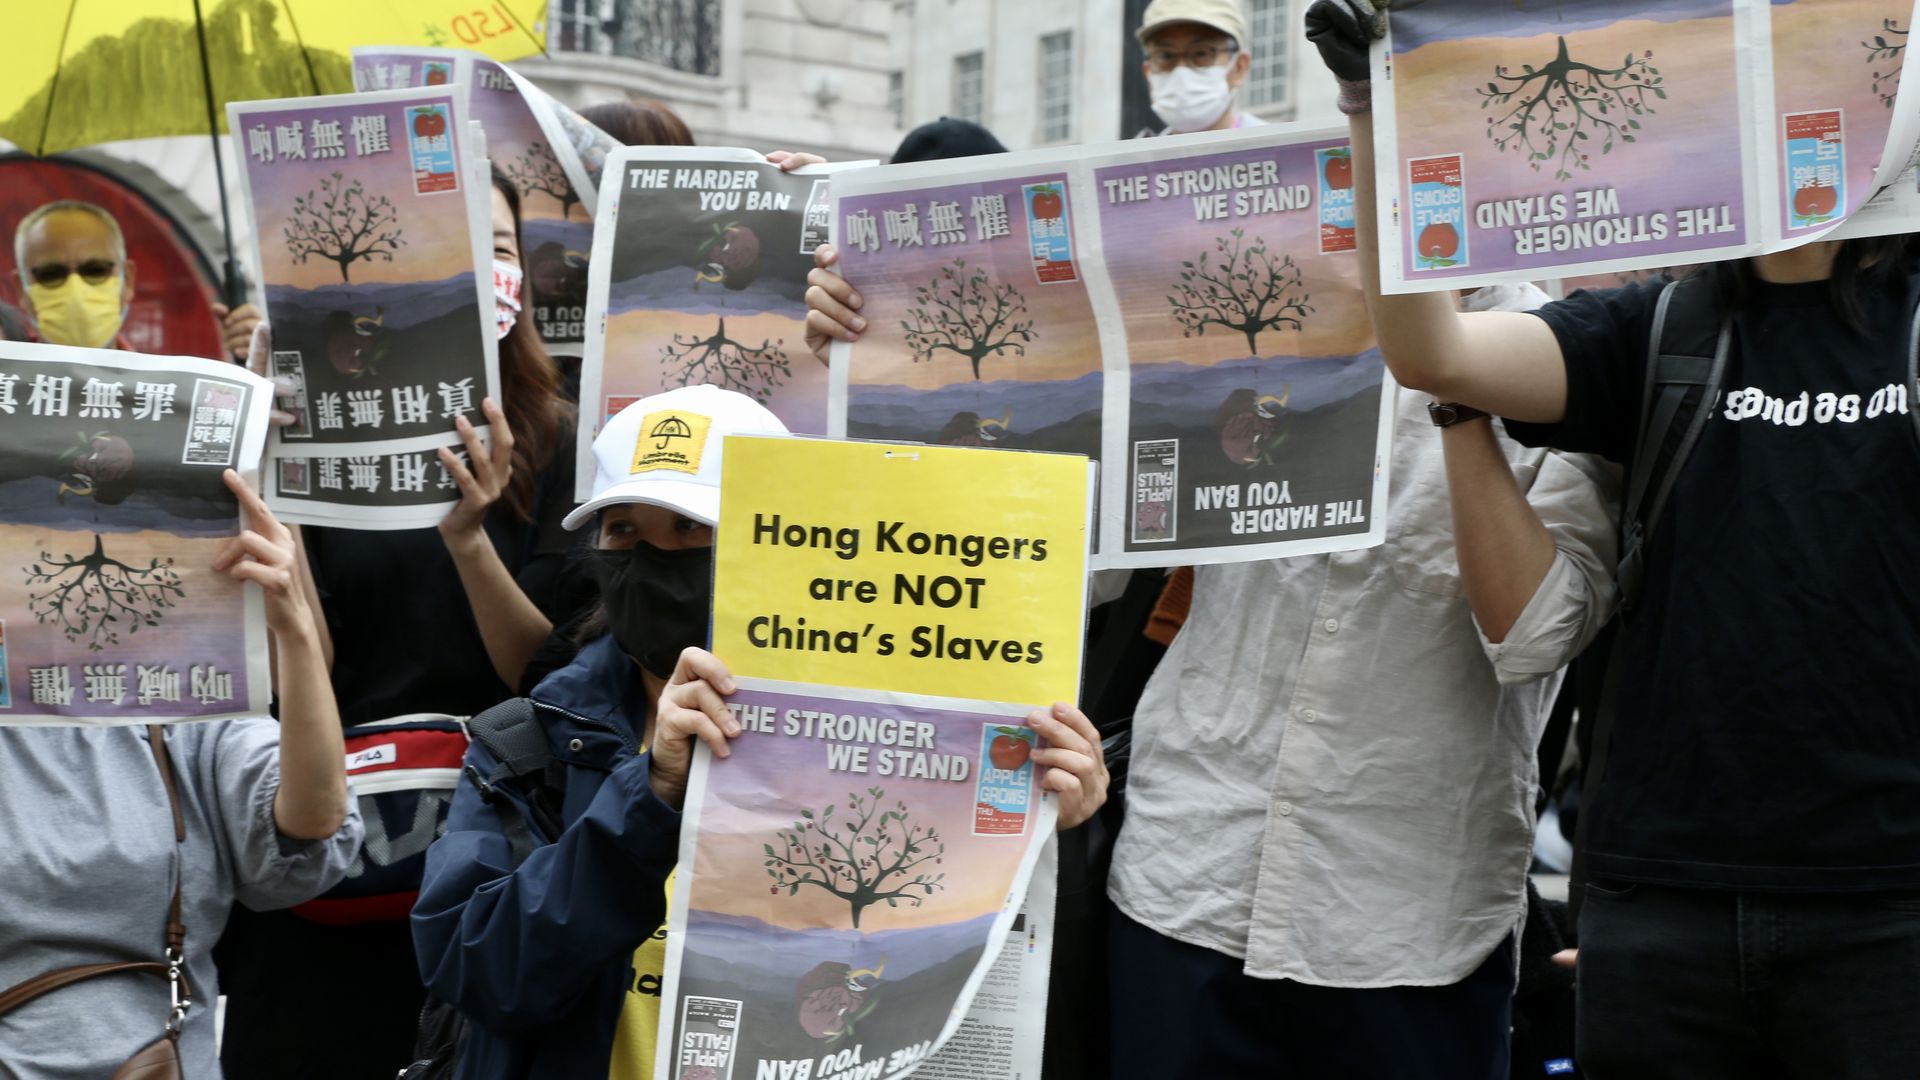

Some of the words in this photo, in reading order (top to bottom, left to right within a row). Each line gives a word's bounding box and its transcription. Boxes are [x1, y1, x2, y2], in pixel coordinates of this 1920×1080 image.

[478, 69, 514, 91] THE
[630, 169, 669, 189] THE
[673, 169, 759, 190] HARDER
[1104, 176, 1149, 204] THE
[1155, 160, 1280, 198] STRONGER
[699, 192, 741, 211] YOU
[745, 192, 791, 211] BAN
[1193, 194, 1229, 221] WE
[1234, 184, 1311, 216] STAND
[1323, 188, 1355, 205] APPL
[1414, 188, 1461, 209] GROWS
[1575, 189, 1621, 218] WE
[846, 194, 1011, 253] 吶喊無懼
[1415, 206, 1462, 227] APPLE
[1475, 194, 1569, 229] STAND
[1676, 205, 1736, 238] THE
[1513, 213, 1669, 256] STRONGER
[556, 306, 584, 321] OU
[315, 377, 476, 430] 真相無罪
[1724, 386, 1810, 427] sand
[1813, 392, 1862, 424] as
[1137, 472, 1174, 487] FALLS
[1137, 486, 1174, 503] APPLE
[1194, 485, 1240, 511] BAN
[1246, 481, 1293, 507] YOU
[1231, 505, 1319, 535] HARDER
[1323, 499, 1366, 527] THE
[753, 513, 860, 561] Hong
[876, 520, 1048, 567] Kongers
[809, 575, 878, 604] are
[893, 573, 986, 609] NOT
[747, 614, 895, 656] China's
[909, 624, 1044, 664] Slaves
[28, 664, 234, 706] 吶喊無懼
[727, 703, 777, 733] THE
[783, 708, 936, 750] STRONGER
[353, 750, 383, 765] FILA
[826, 743, 870, 774] WE
[876, 749, 970, 783] STAND
[981, 767, 1028, 787] APPLE
[979, 786, 1026, 806] GROWS
[683, 1031, 732, 1051] FALLS
[681, 1049, 730, 1069] APPLE
[755, 1058, 815, 1080] BAN
[816, 1043, 863, 1078] YOU
